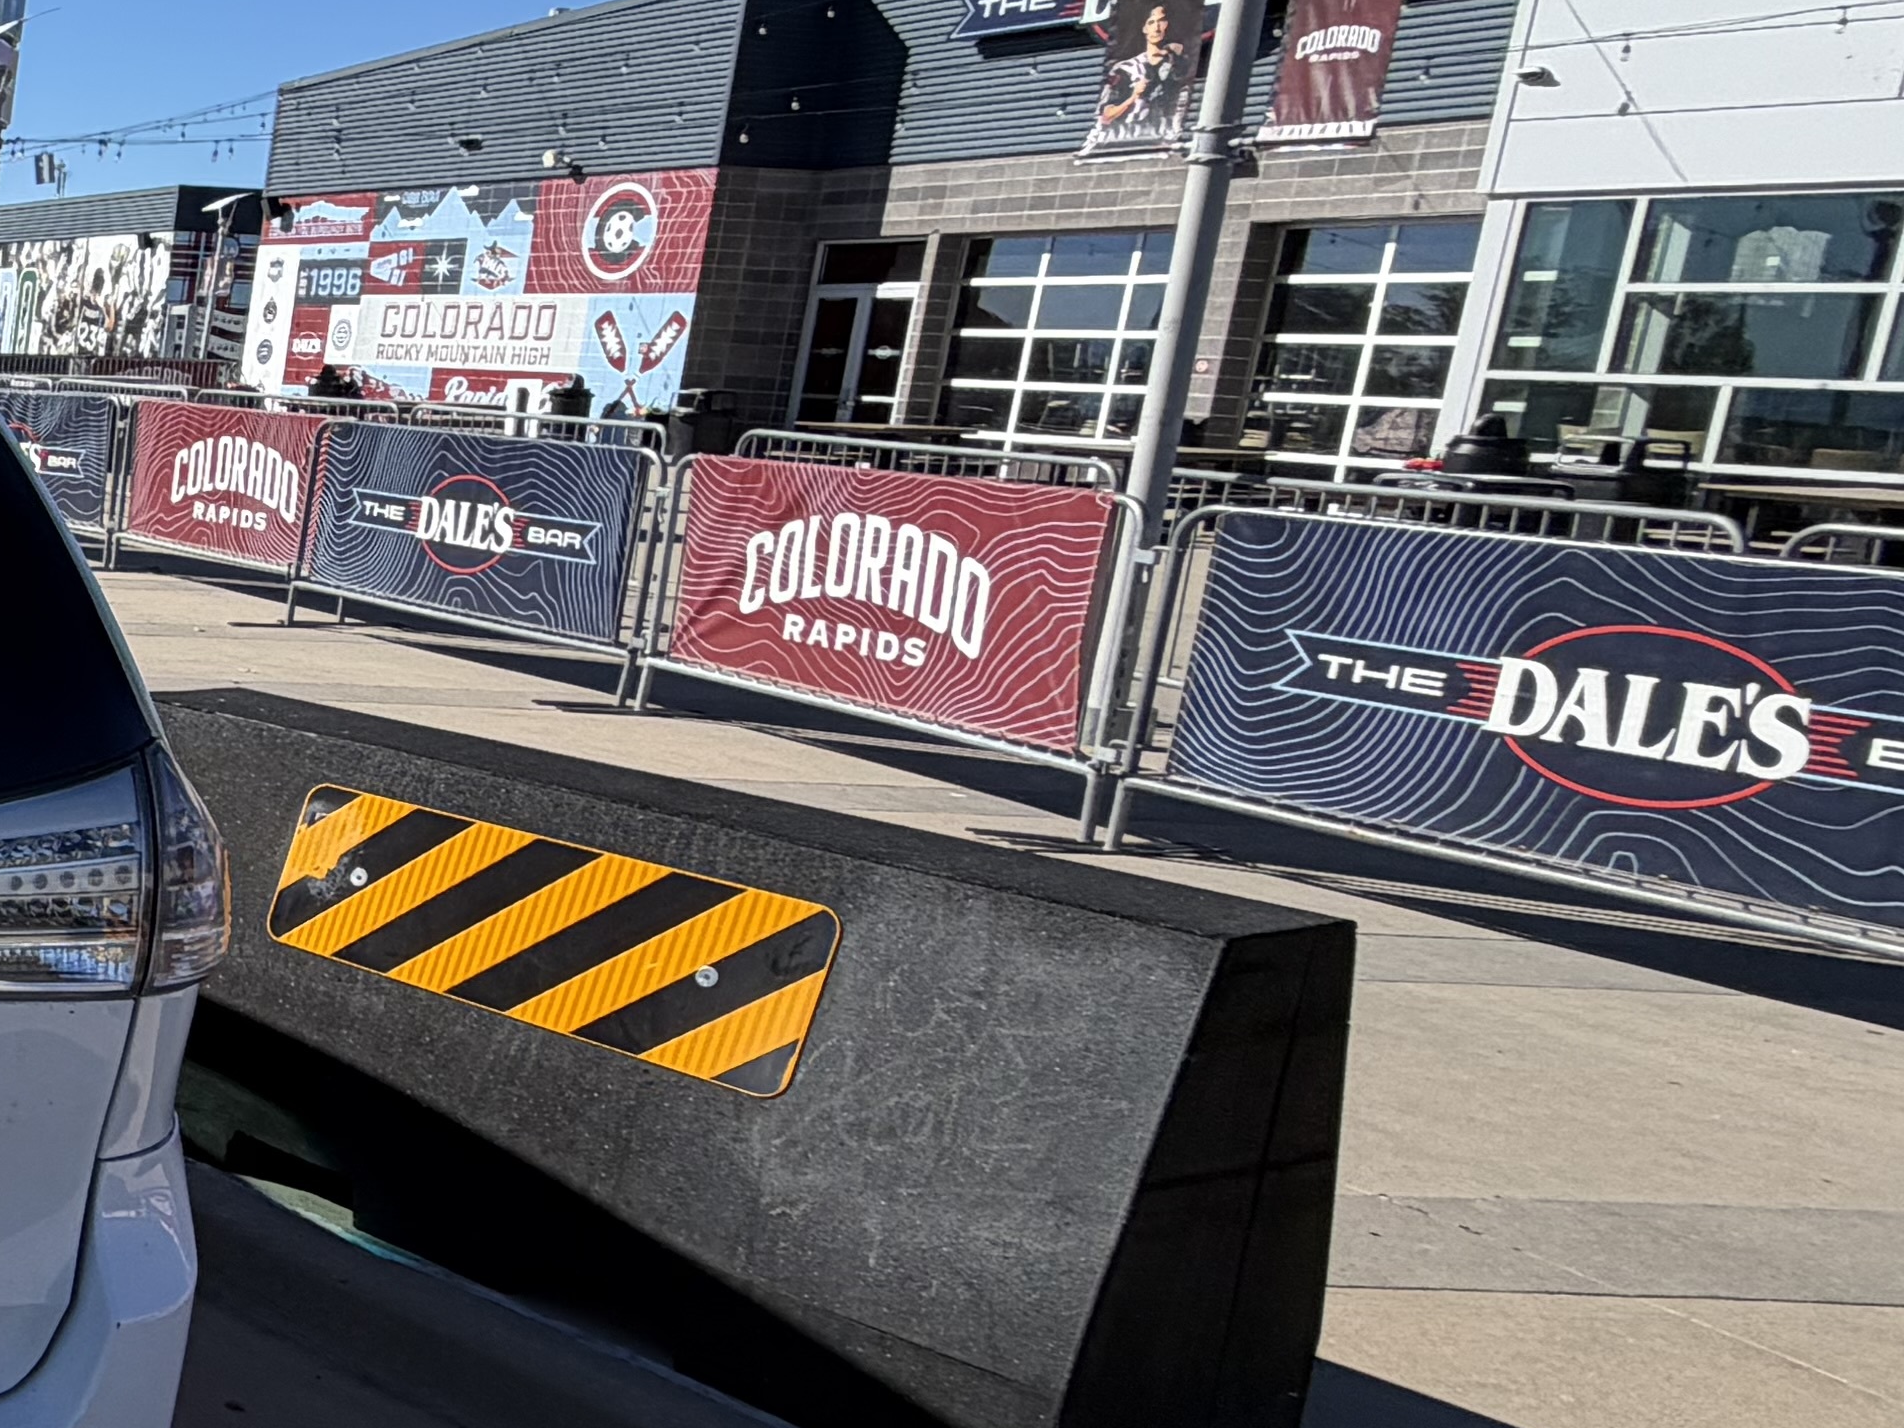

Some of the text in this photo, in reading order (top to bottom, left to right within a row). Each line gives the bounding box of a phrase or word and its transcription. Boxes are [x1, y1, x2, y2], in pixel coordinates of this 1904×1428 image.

[1294, 25, 1381, 60] COLORADO
[1309, 51, 1360, 63] RAPIDS
[310, 267, 362, 297] 1996
[380, 301, 558, 341] COLORADO
[376, 343, 552, 366] ROCKY MOUNTAIN HIGH
[47, 456, 77, 469] BAR
[170, 436, 299, 523] COLORADO
[192, 501, 267, 531] RAPIDS
[363, 496, 582, 554] THE DALE'S BAR
[739, 512, 991, 660] COLORADO
[782, 613, 928, 668] RAPIDS
[1317, 654, 1448, 697] THE
[1482, 656, 1814, 781] DALE'S
